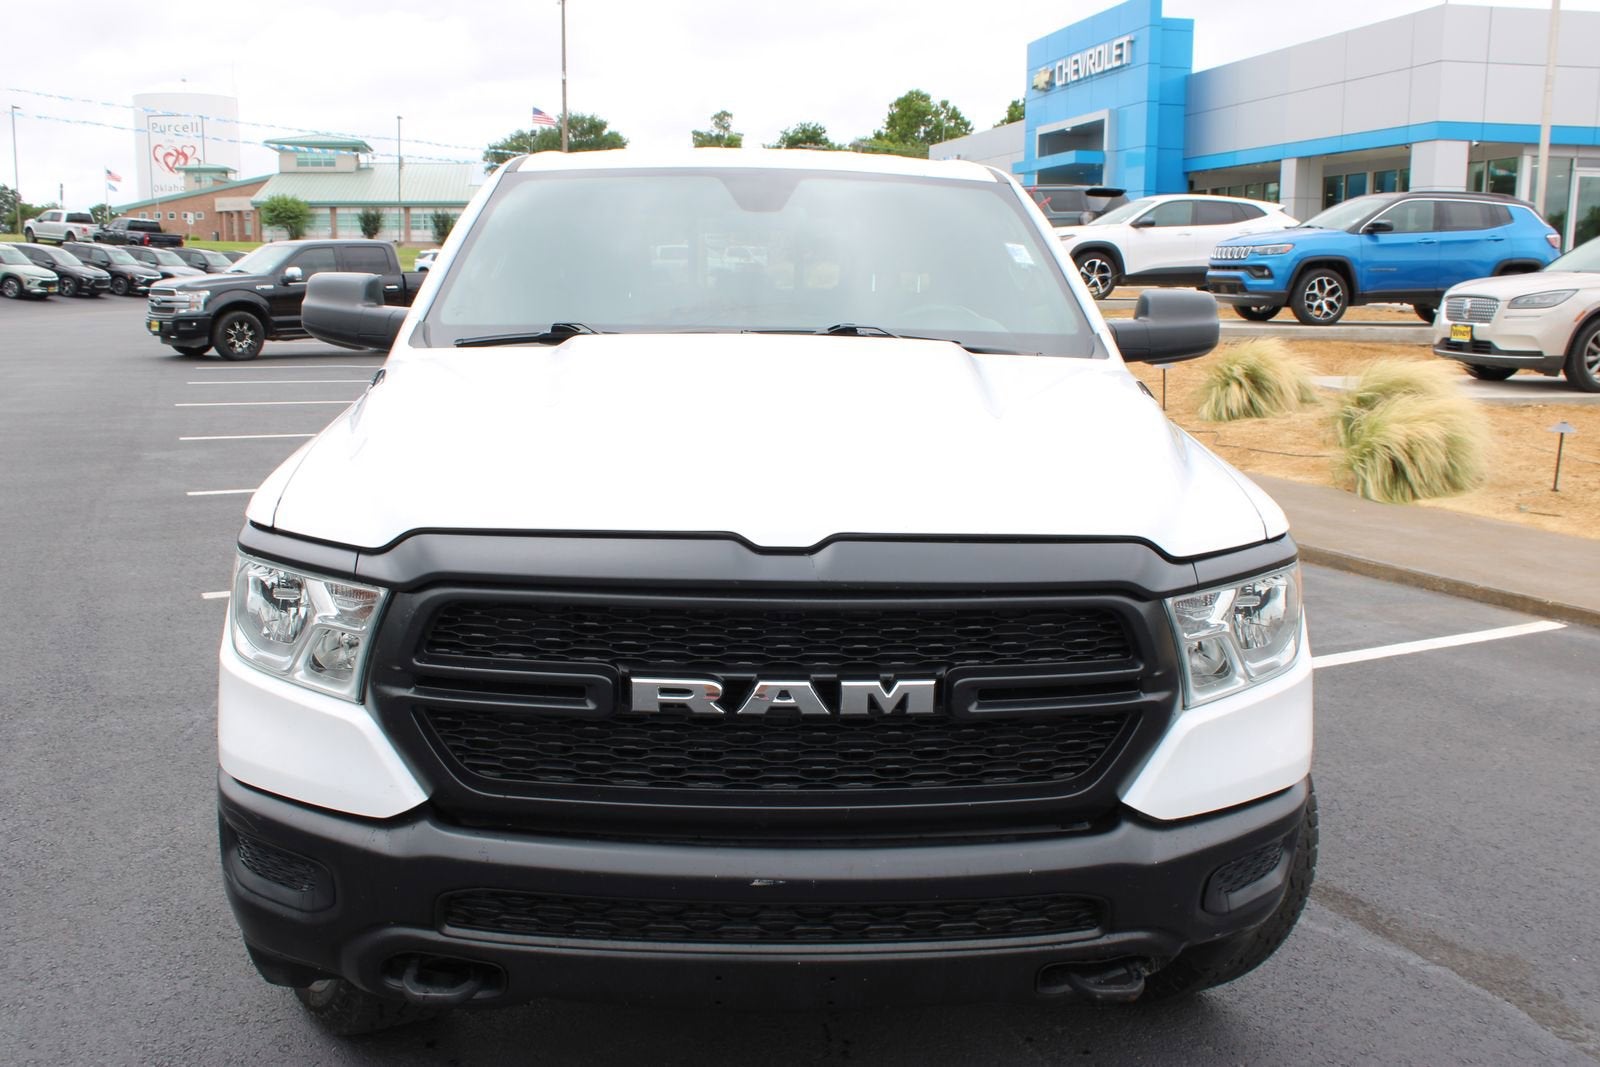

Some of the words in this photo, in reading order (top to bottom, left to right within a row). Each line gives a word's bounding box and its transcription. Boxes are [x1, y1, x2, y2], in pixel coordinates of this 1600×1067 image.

[1055, 36, 1132, 86] CHEVROLET
[151, 122, 199, 133] Purcell
[153, 183, 185, 192] Oklaho
[630, 677, 936, 715] RAM
